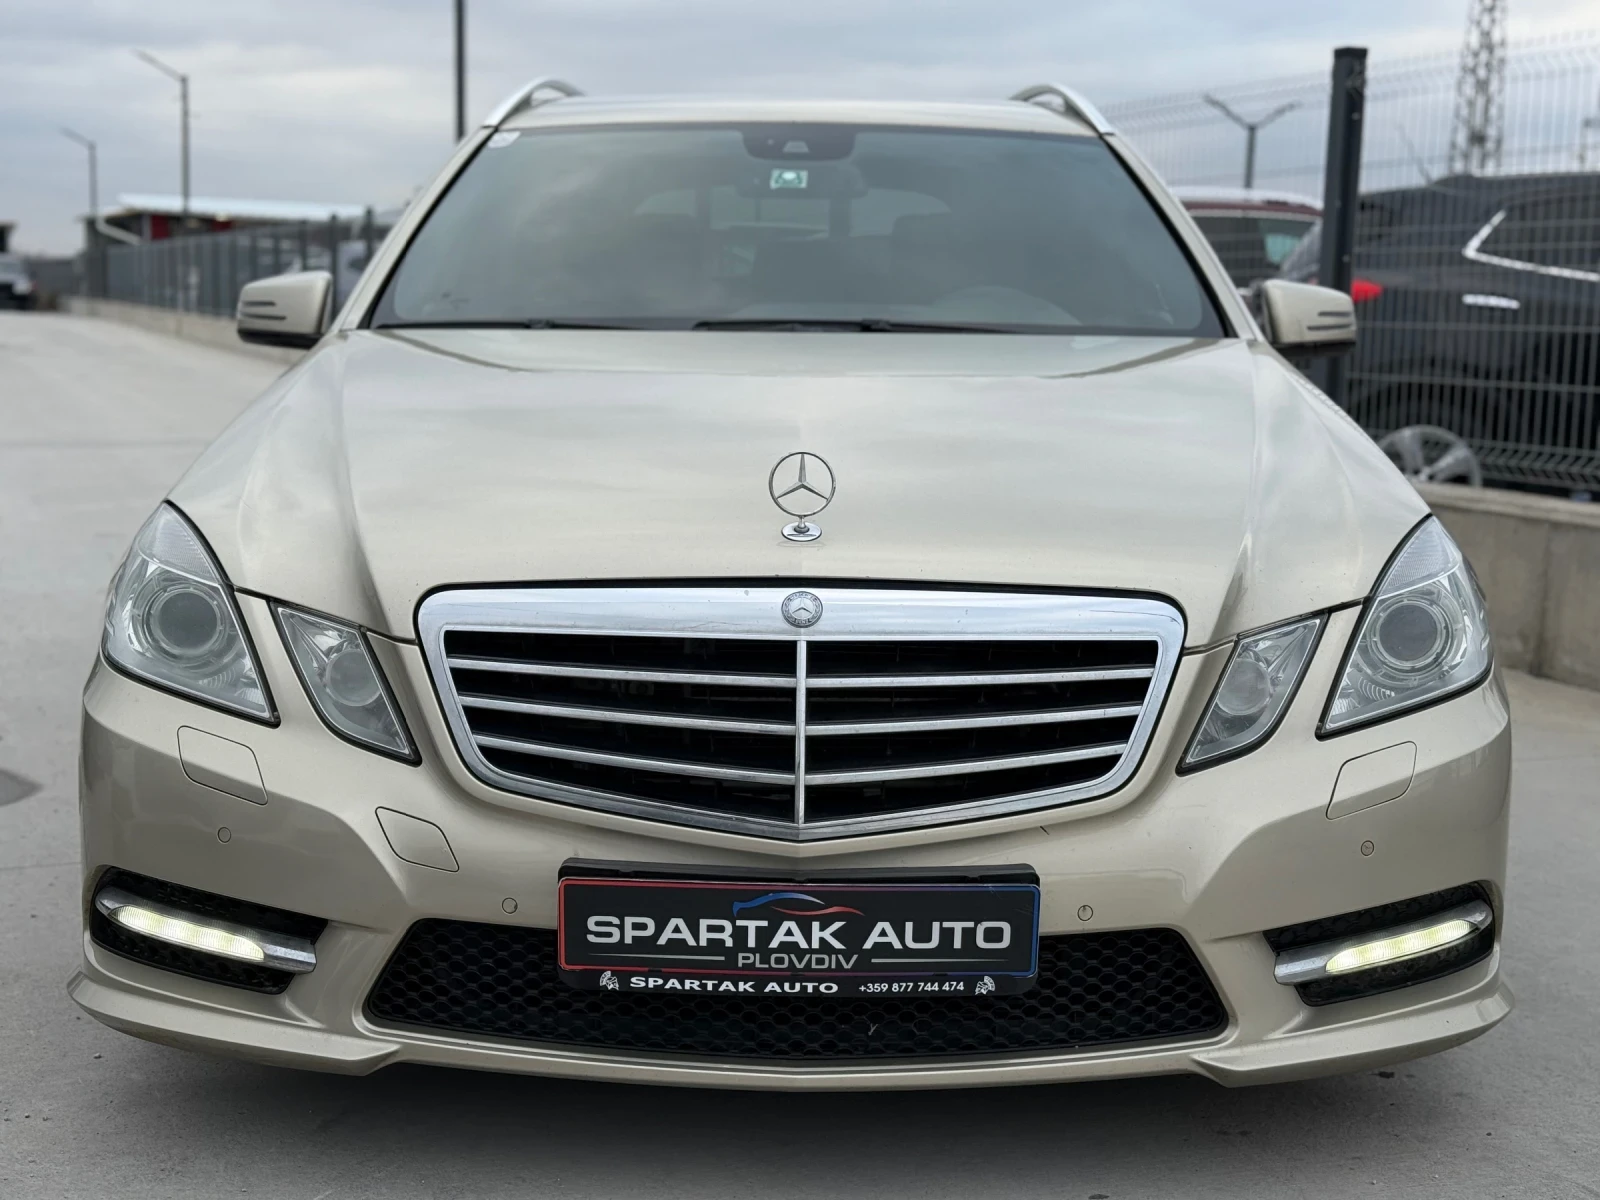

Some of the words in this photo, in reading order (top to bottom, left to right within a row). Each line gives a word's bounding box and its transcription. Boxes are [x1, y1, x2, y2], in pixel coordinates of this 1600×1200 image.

[586, 915, 847, 949] SPARTAK
[862, 921, 1011, 950] AUTO
[737, 952, 859, 969] PLOVDIV
[629, 976, 755, 992] SPARTAK
[763, 981, 839, 994] AUTO
[858, 982, 889, 993] +359
[891, 982, 914, 993] 877
[917, 981, 940, 992] 744
[941, 981, 965, 991] 474
